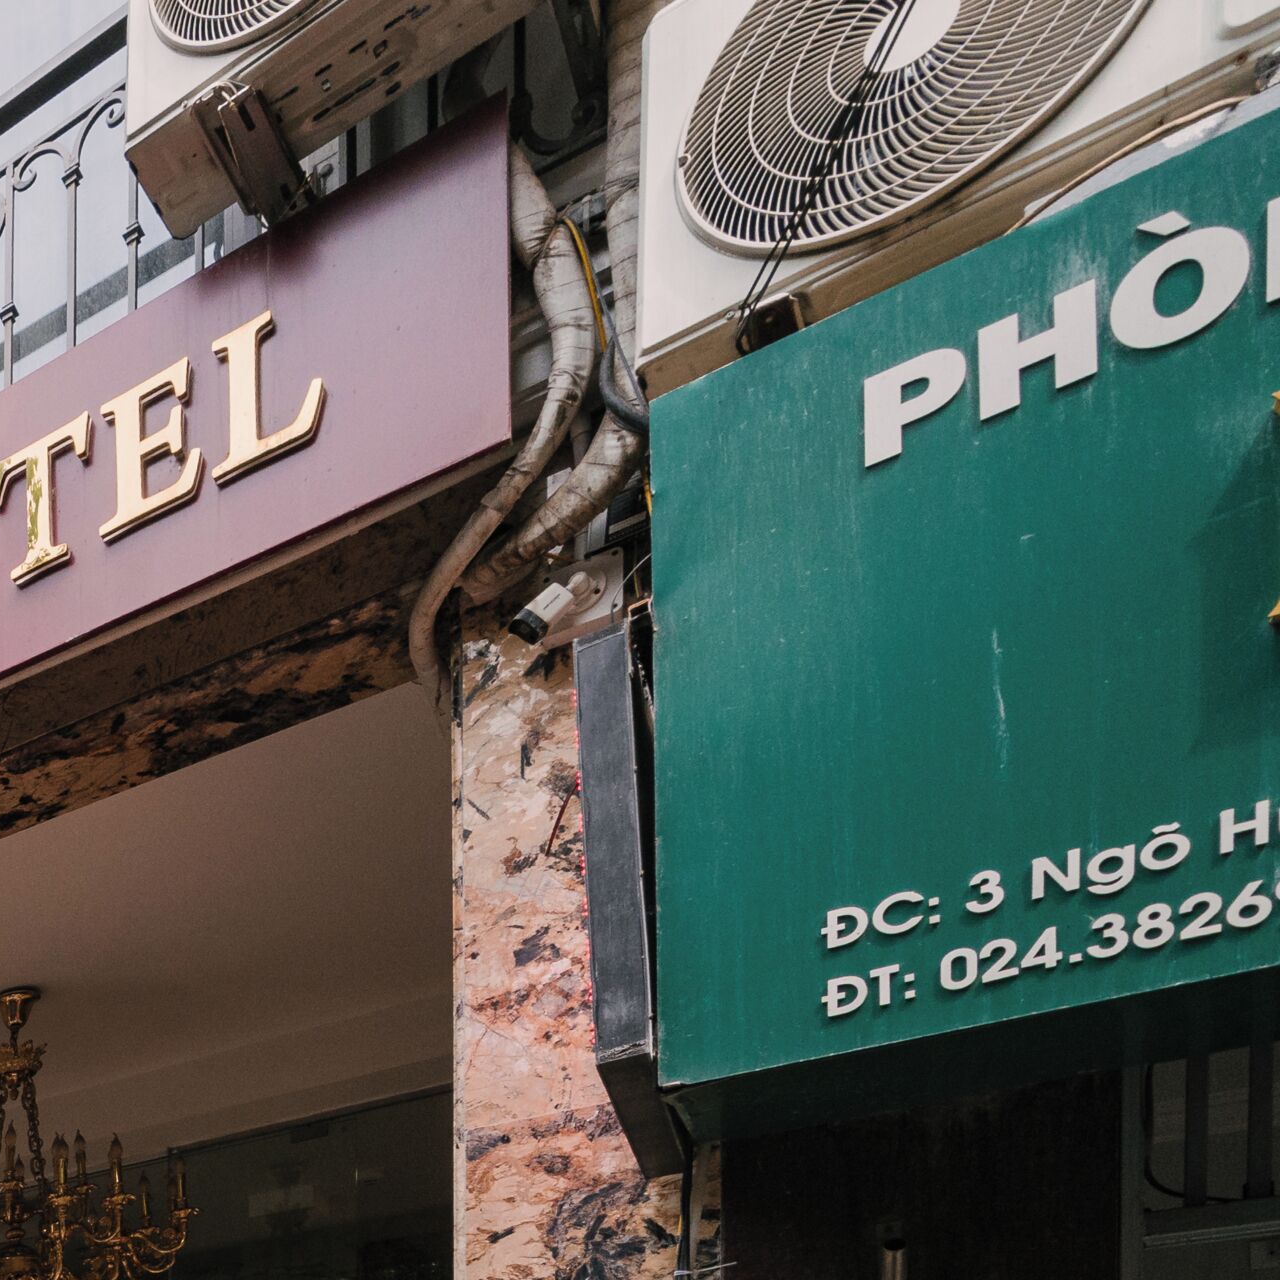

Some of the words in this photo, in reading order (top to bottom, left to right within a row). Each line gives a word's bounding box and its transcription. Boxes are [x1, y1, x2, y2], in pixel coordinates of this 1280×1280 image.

[864, 196, 1280, 468] PHÒ
[821, 890, 941, 949] ĐC:
[965, 869, 1006, 914] 3
[1031, 821, 1192, 900] Ngõ
[1219, 799, 1280, 854] H
[821, 963, 917, 1017] ĐT:
[940, 879, 1280, 991] 024.3826
